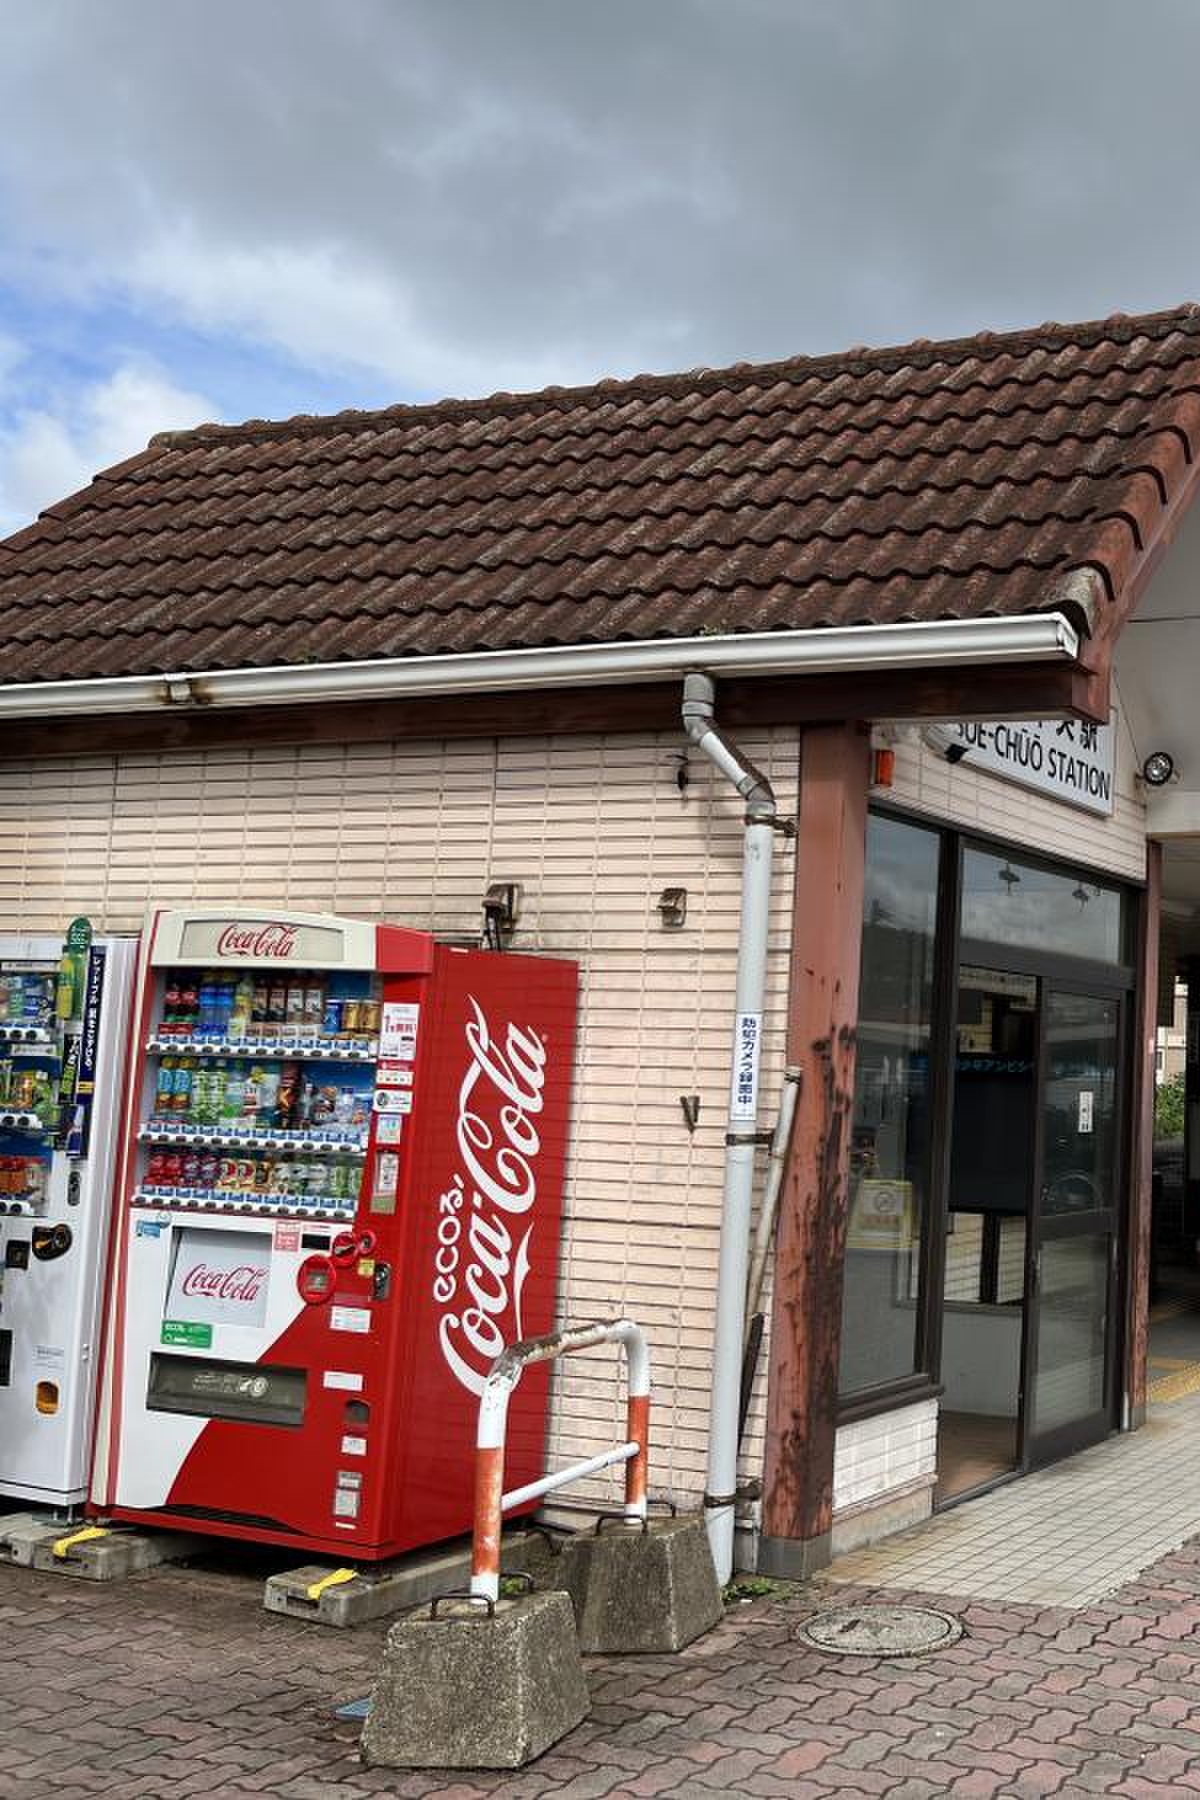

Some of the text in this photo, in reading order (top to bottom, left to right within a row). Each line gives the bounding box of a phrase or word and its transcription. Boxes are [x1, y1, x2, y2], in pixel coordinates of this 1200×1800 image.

[1047, 748, 1110, 800] STATION
[217, 923, 299, 957] Coca-Cola
[439, 993, 547, 1398] Coca-Cola
[183, 1263, 268, 1301] Coca-Cola
